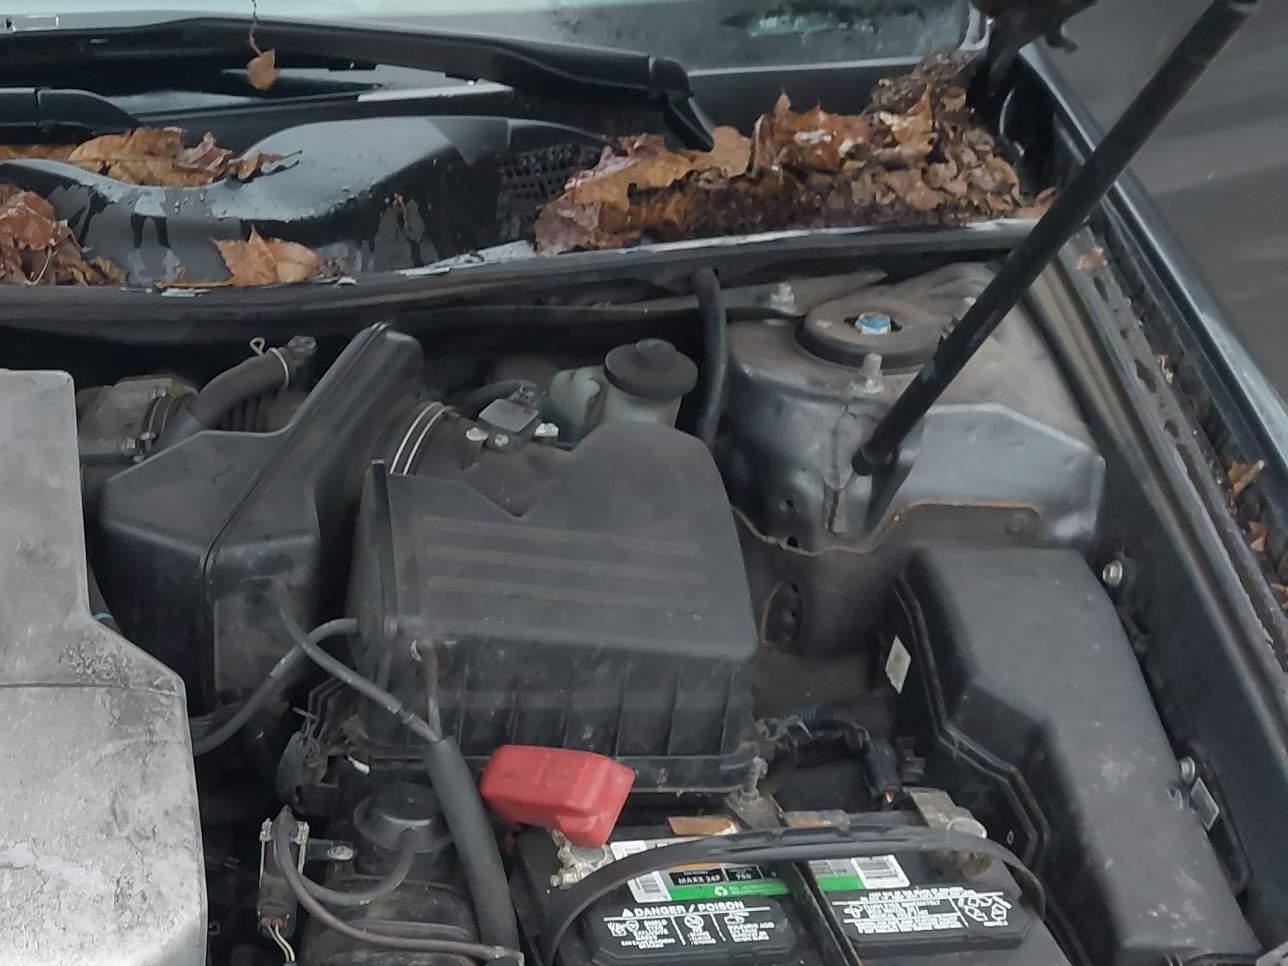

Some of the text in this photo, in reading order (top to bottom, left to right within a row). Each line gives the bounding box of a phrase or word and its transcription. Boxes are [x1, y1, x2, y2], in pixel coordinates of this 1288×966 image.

[677, 875, 705, 885] MAXX
[634, 905, 686, 917] DANGER
[697, 901, 744, 913] POISON
